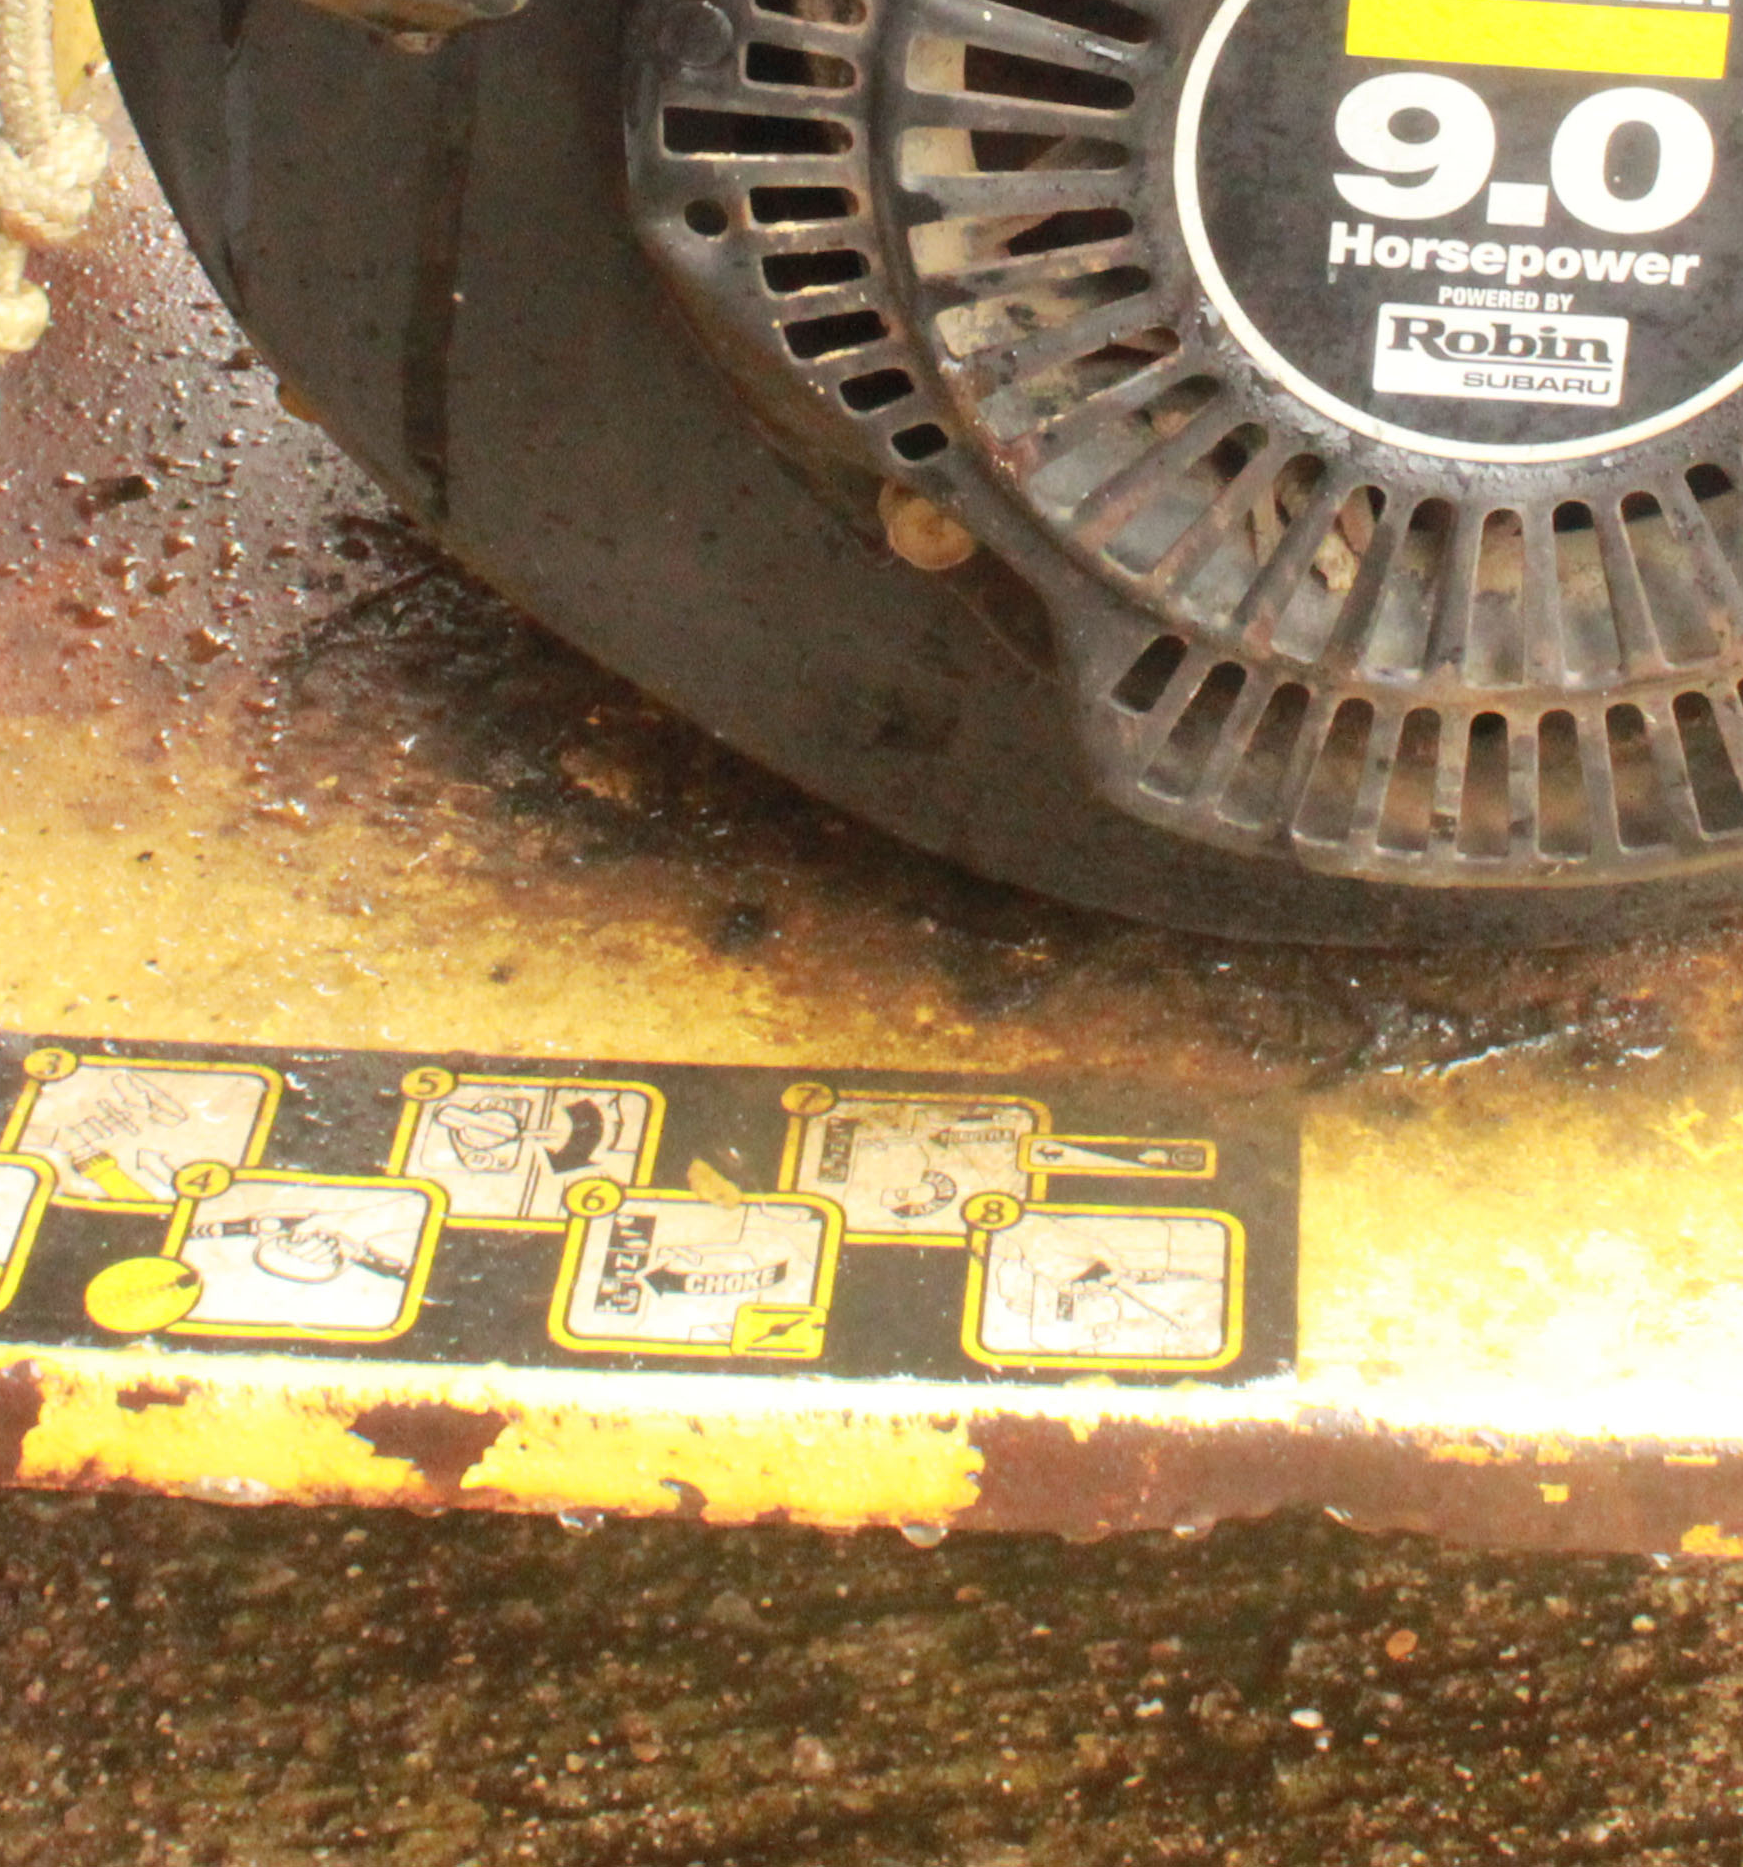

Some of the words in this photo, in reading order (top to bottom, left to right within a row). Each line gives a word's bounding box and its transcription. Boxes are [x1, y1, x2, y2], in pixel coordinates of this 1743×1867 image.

[1332, 71, 1715, 234] 9.0
[1328, 221, 1700, 287] Horsepower
[1438, 285, 1540, 311] POWERED
[1545, 291, 1574, 313] BY
[1386, 315, 1613, 364] Robin
[1462, 371, 1612, 395] SUBARU
[42, 1053, 62, 1075] 3
[416, 1071, 441, 1096] 5
[796, 1086, 823, 1110] 7
[186, 1169, 212, 1192] 4
[581, 1185, 606, 1212] 6
[980, 1199, 1004, 1224] 8
[683, 1266, 777, 1294] CHOKE
